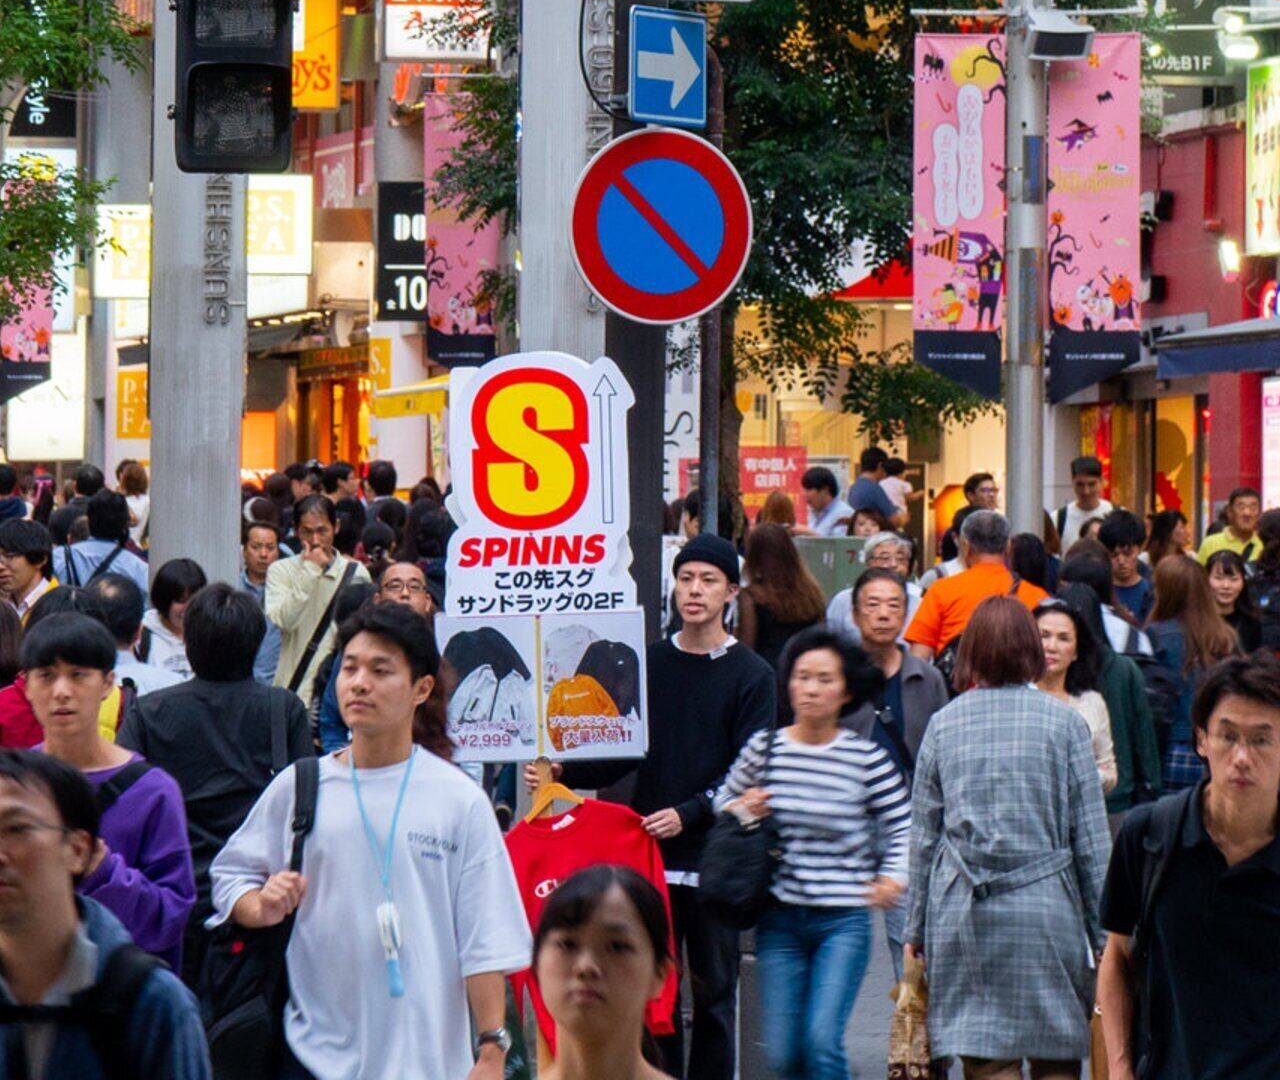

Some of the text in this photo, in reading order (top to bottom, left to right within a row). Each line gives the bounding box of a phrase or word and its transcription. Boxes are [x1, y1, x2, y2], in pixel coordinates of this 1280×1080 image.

[479, 374, 583, 524] S
[458, 533, 607, 569] SPINNS
[493, 569, 595, 591] この先スグ
[456, 591, 625, 616] サンドラッグの2F
[457, 733, 512, 748] ¥2,999
